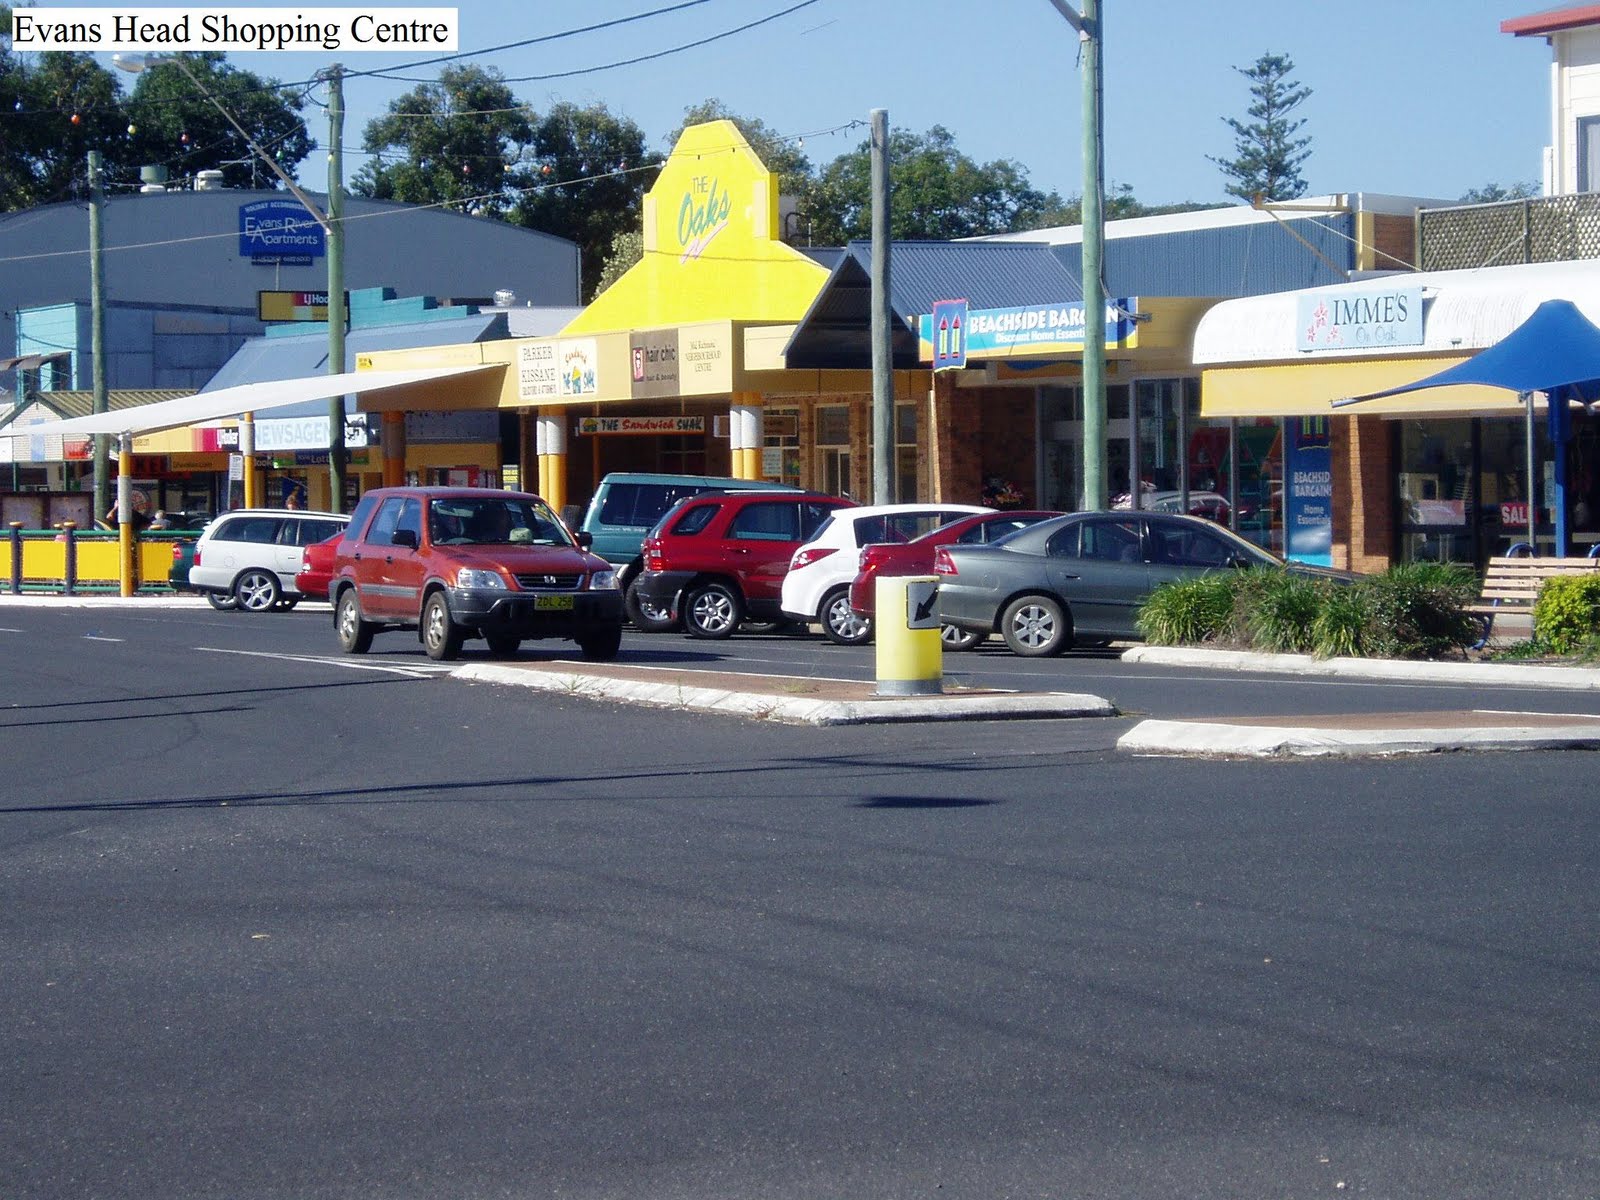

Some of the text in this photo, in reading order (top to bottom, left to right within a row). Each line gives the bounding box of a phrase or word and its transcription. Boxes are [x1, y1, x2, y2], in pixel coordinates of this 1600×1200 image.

[692, 175, 709, 194] THE
[677, 177, 733, 246] Oaks
[245, 216, 314, 236] Evans River
[250, 225, 319, 246] Apartments
[312, 294, 329, 304] Hoo
[1333, 292, 1408, 326] IMME'S
[969, 309, 1046, 334] BEACHSIDE
[995, 327, 1086, 344] Discount Home Essenti
[522, 345, 554, 361] PARKER
[645, 344, 676, 362] hair chic
[521, 367, 557, 383] KISSANE
[601, 415, 702, 431] THE Sandwich SHAK
[1294, 471, 1330, 483] BEACHSID
[1303, 504, 1324, 514] Home
[1501, 506, 1528, 525] SAL
